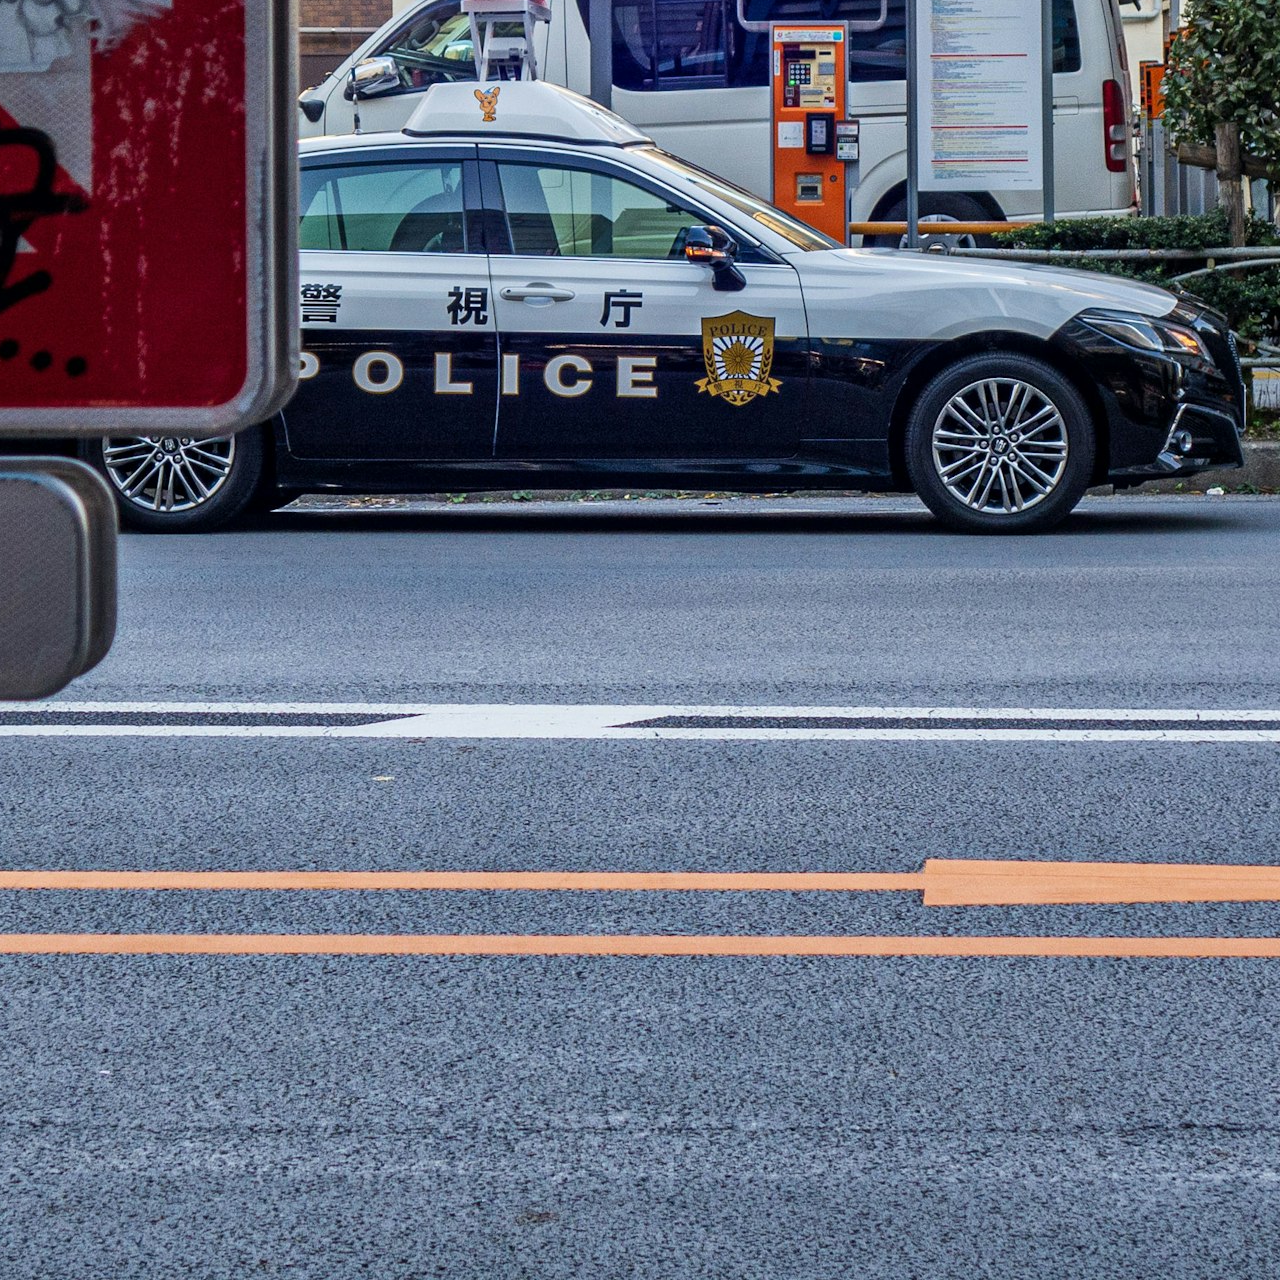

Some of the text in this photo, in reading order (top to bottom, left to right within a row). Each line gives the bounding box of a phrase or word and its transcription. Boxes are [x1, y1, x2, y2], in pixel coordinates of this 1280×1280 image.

[299, 282, 644, 329] 警視庁
[709, 323, 767, 337] POLICE
